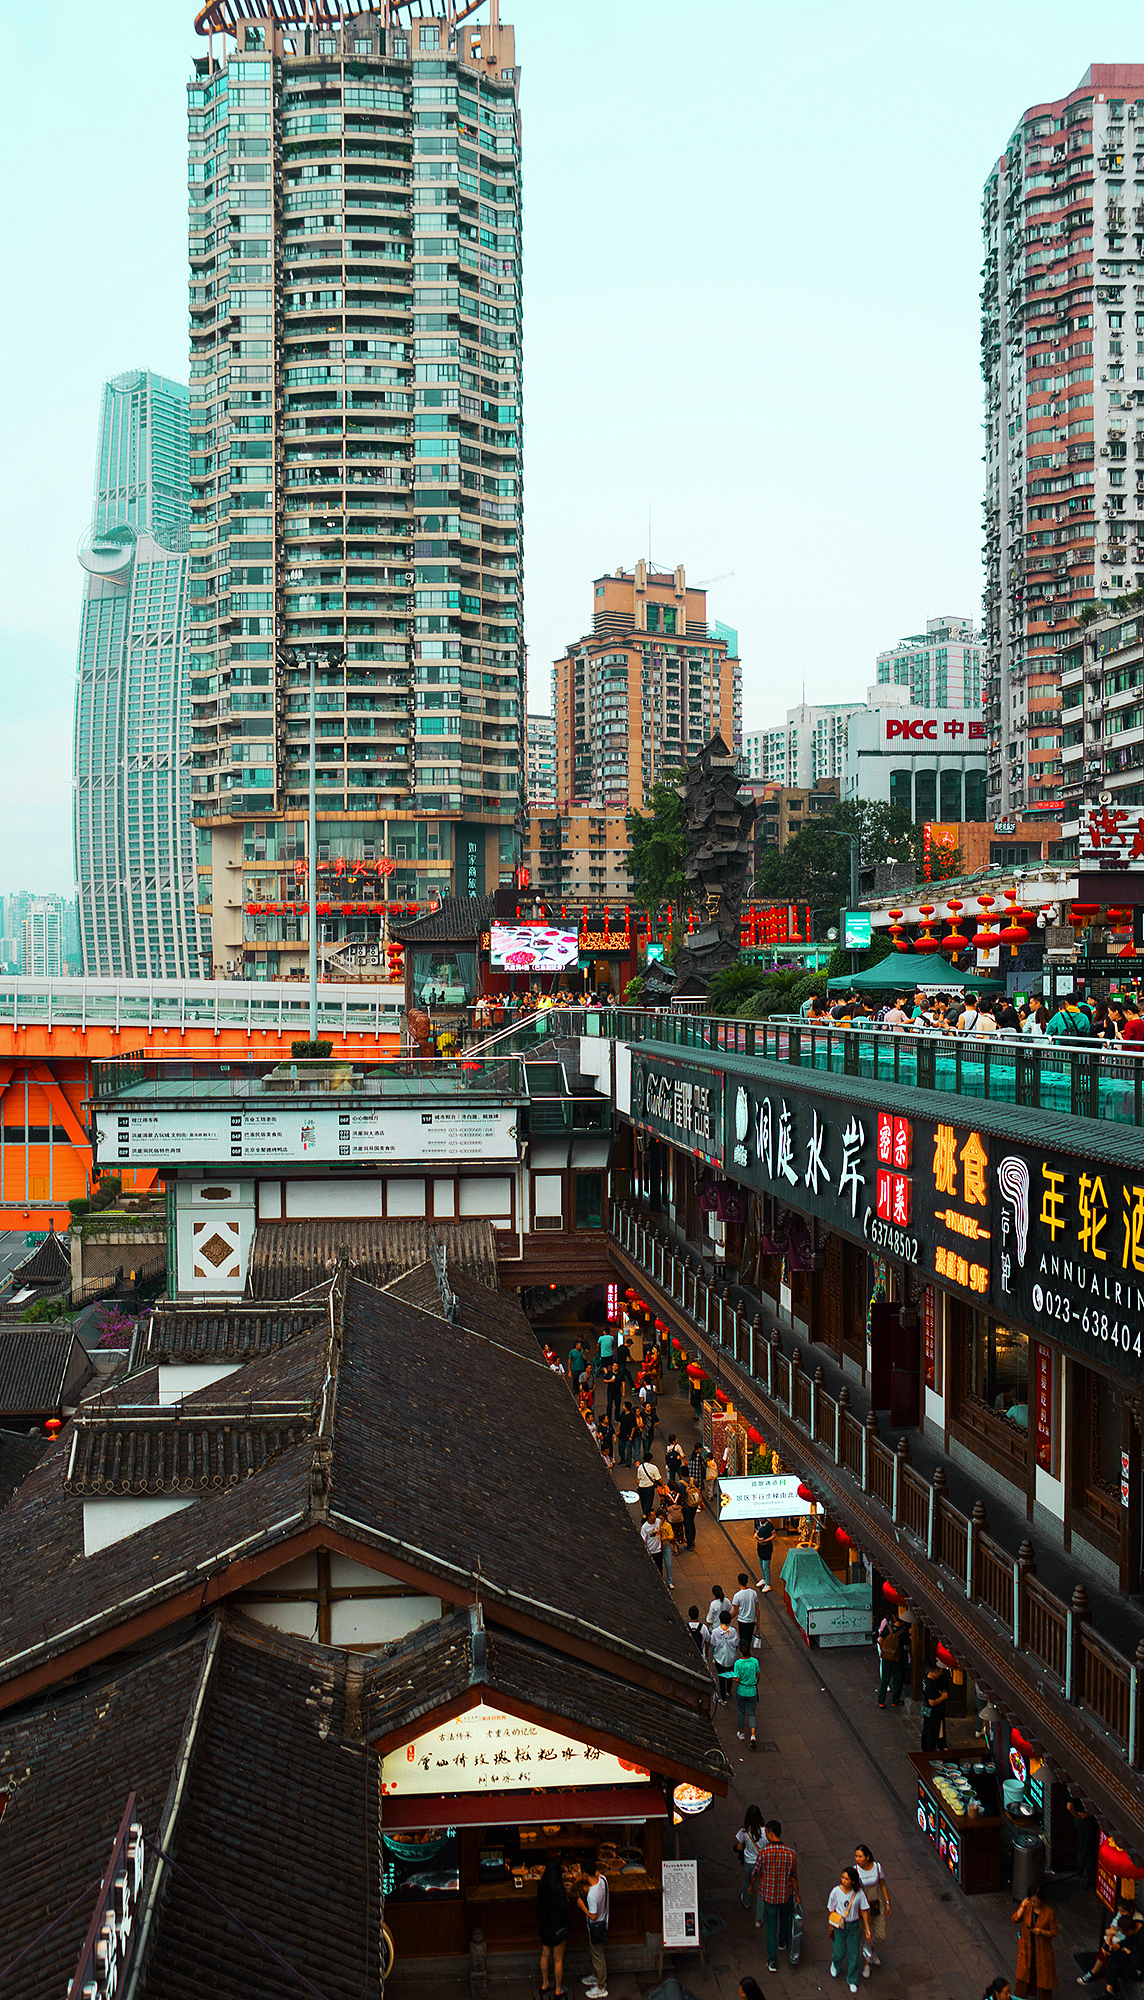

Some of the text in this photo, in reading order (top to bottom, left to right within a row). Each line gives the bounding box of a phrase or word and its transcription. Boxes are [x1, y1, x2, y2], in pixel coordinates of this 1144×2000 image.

[886, 719, 938, 740] PICC
[943, 719, 987, 740] 中国
[340, 903, 421, 916] 重庆老字号
[755, 1096, 866, 1218] 洞庭水岸
[877, 1175, 909, 1224] 川菜
[871, 1218, 918, 1264] 63748502
